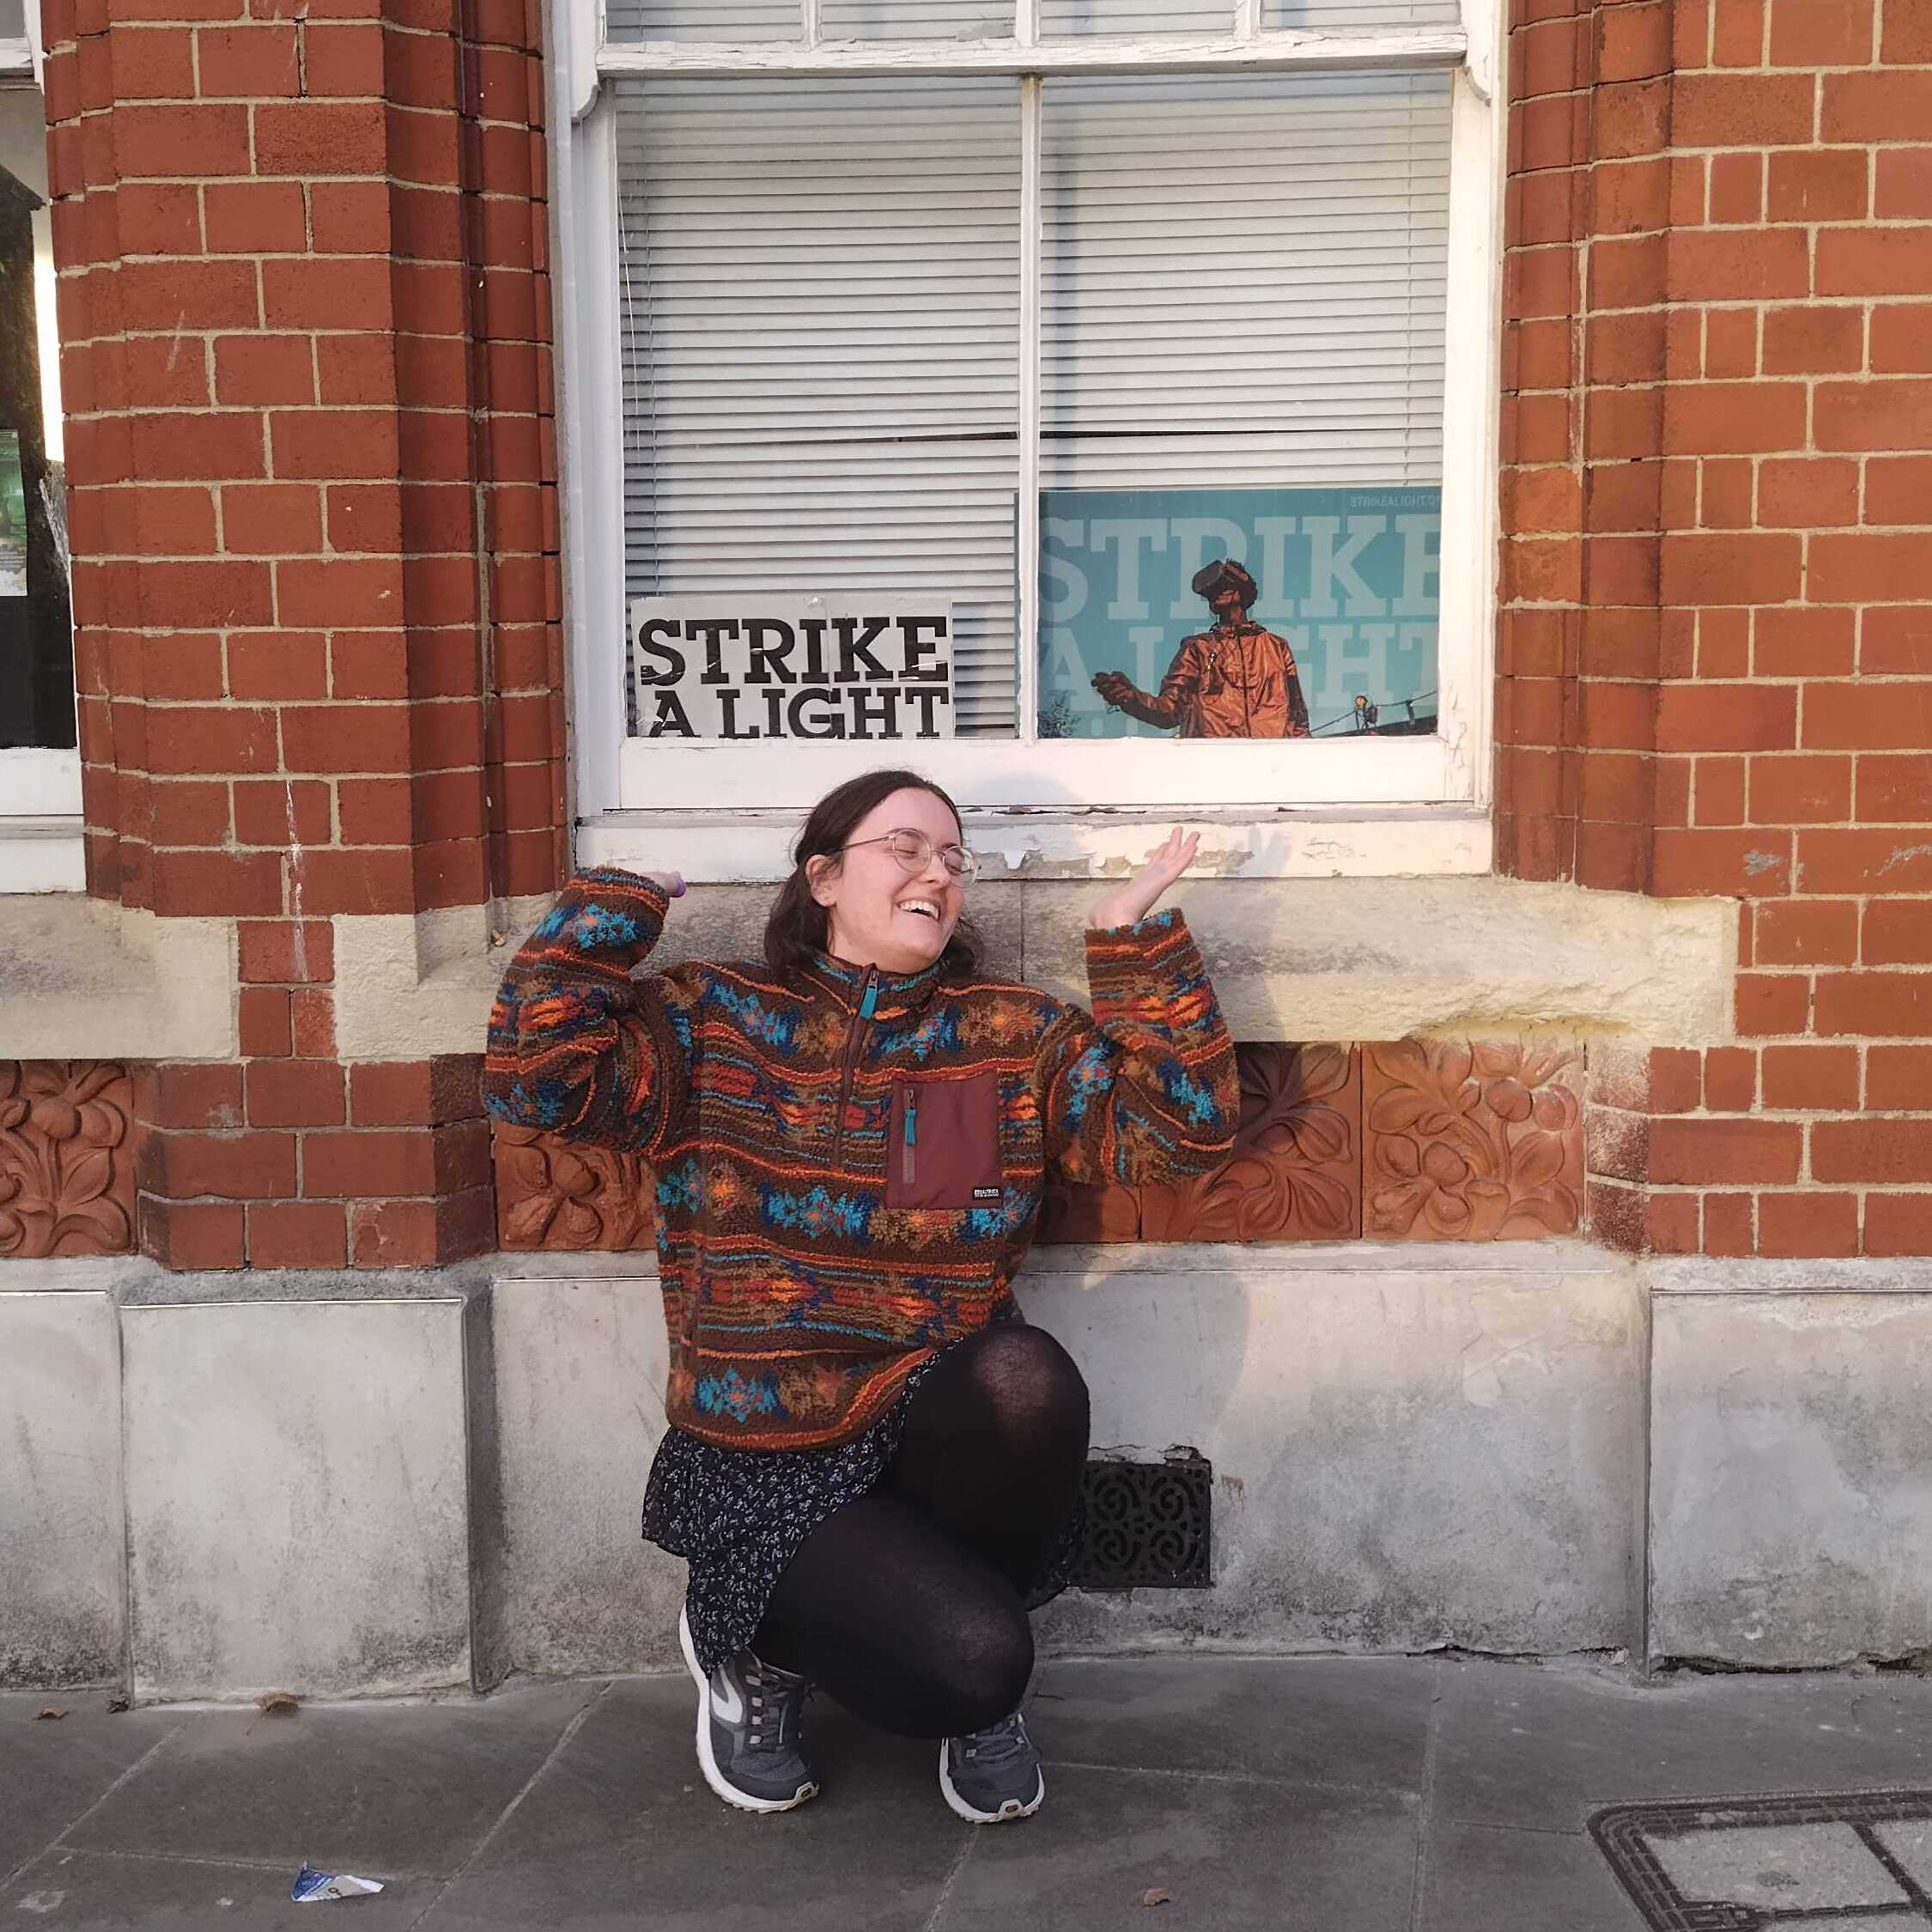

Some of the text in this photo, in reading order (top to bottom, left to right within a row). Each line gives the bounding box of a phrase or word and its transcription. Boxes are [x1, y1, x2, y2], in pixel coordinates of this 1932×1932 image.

[638, 616, 949, 686] STRIKE
[642, 686, 949, 739] A LIGHT
